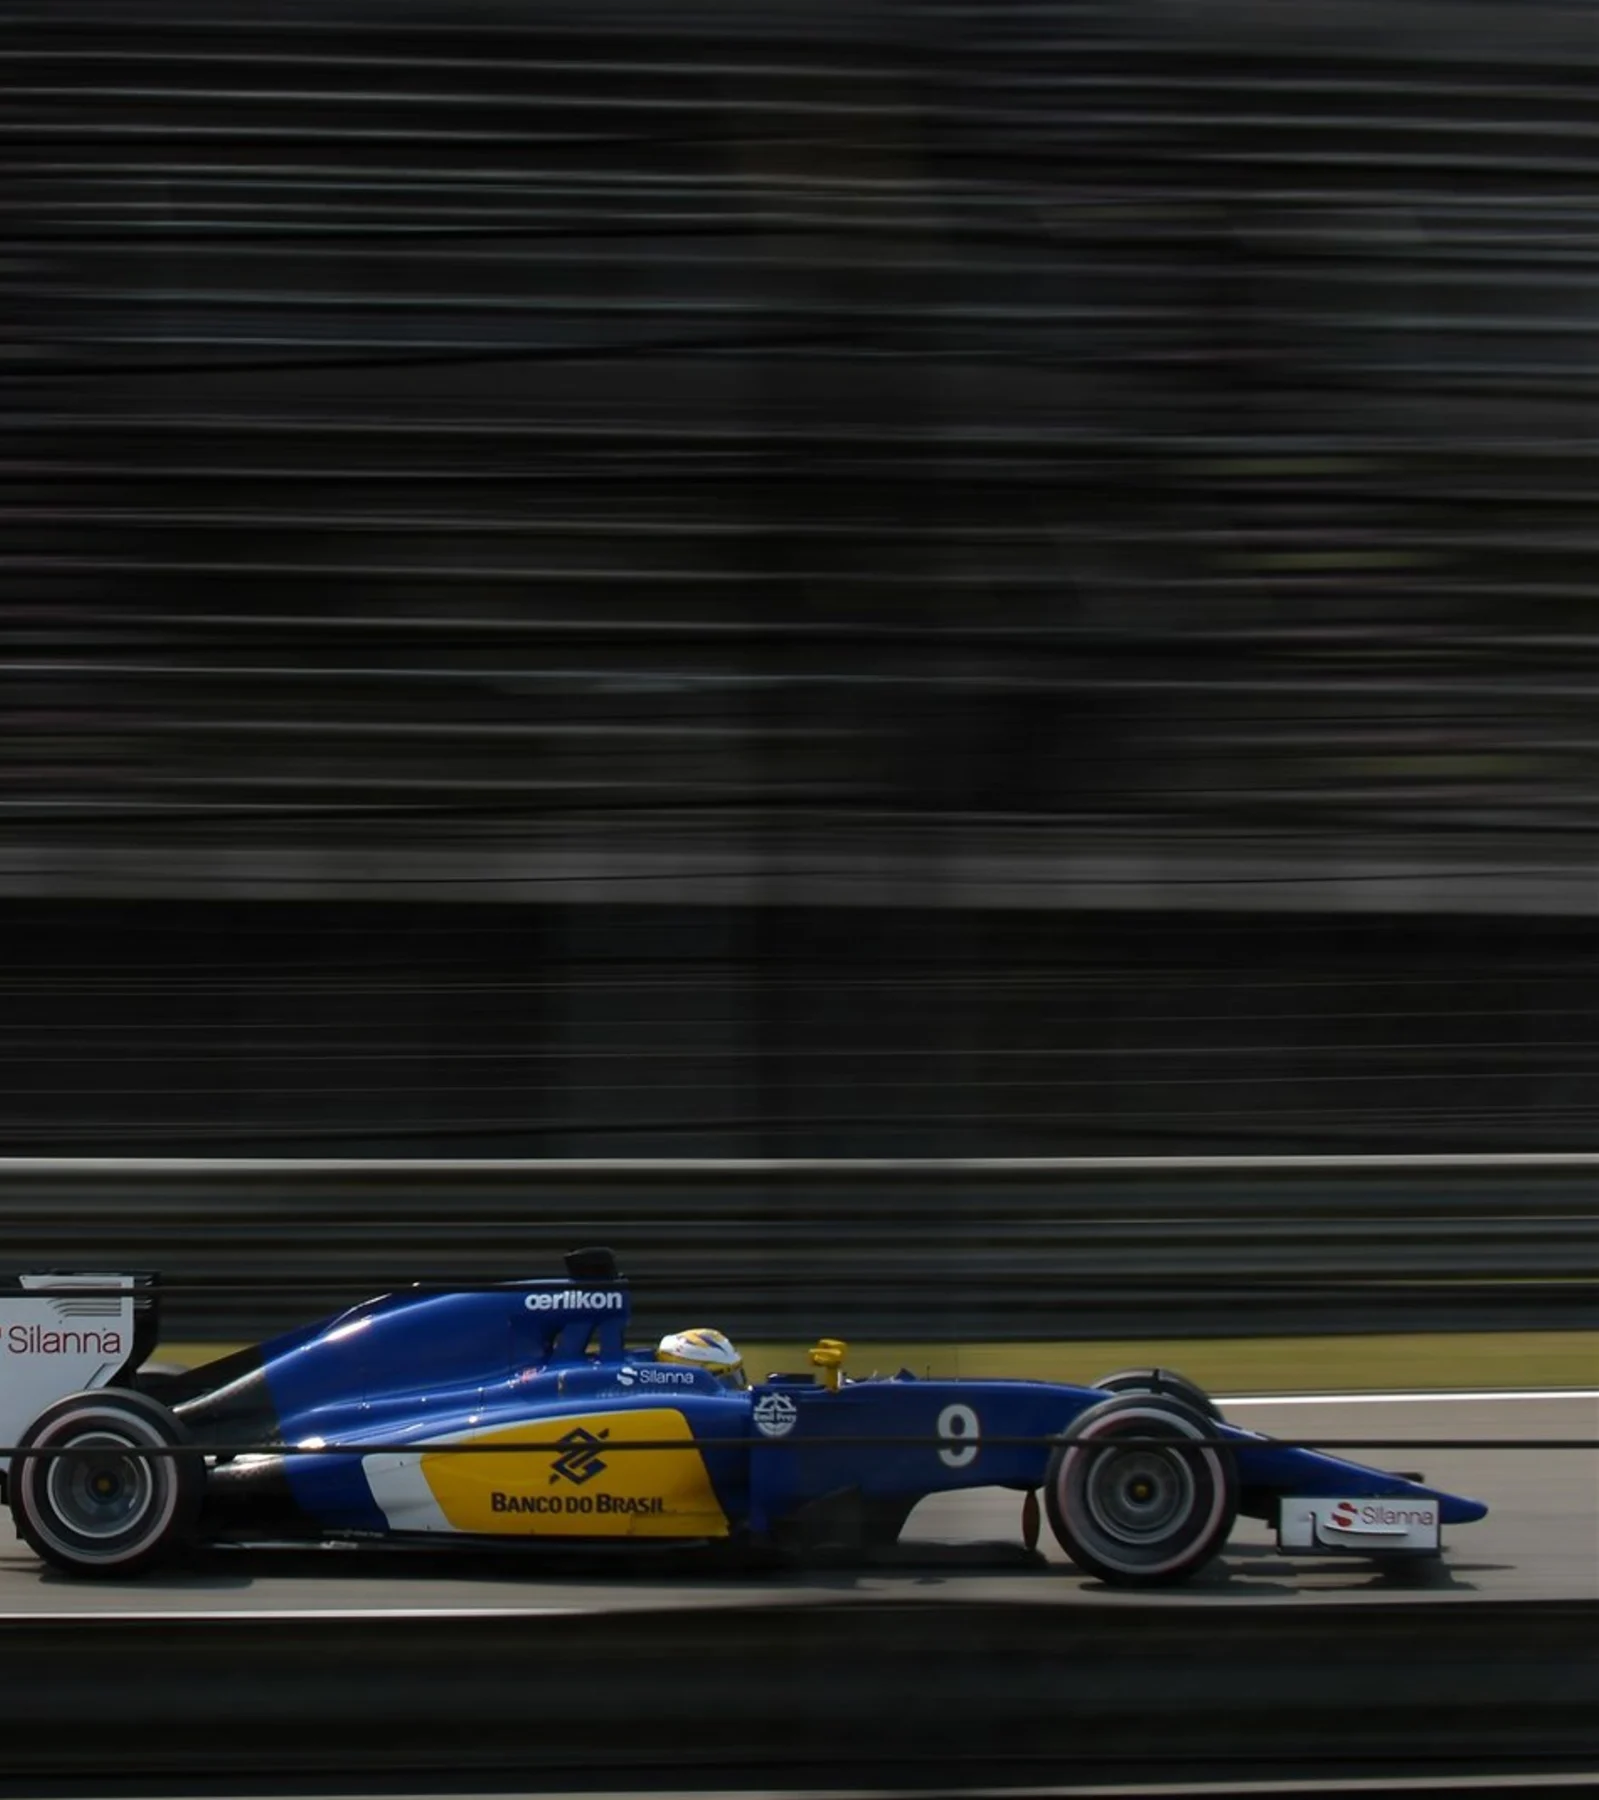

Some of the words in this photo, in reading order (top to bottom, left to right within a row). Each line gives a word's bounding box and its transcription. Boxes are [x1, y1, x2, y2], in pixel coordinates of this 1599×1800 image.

[8, 1324, 121, 1354] Silanna
[640, 1369, 695, 1384] Silanna
[938, 1404, 978, 1467] 9
[491, 1492, 562, 1514] BANCO
[565, 1496, 593, 1514] DO
[596, 1493, 664, 1514] BRASIL
[1361, 1506, 1434, 1526] Silanna
